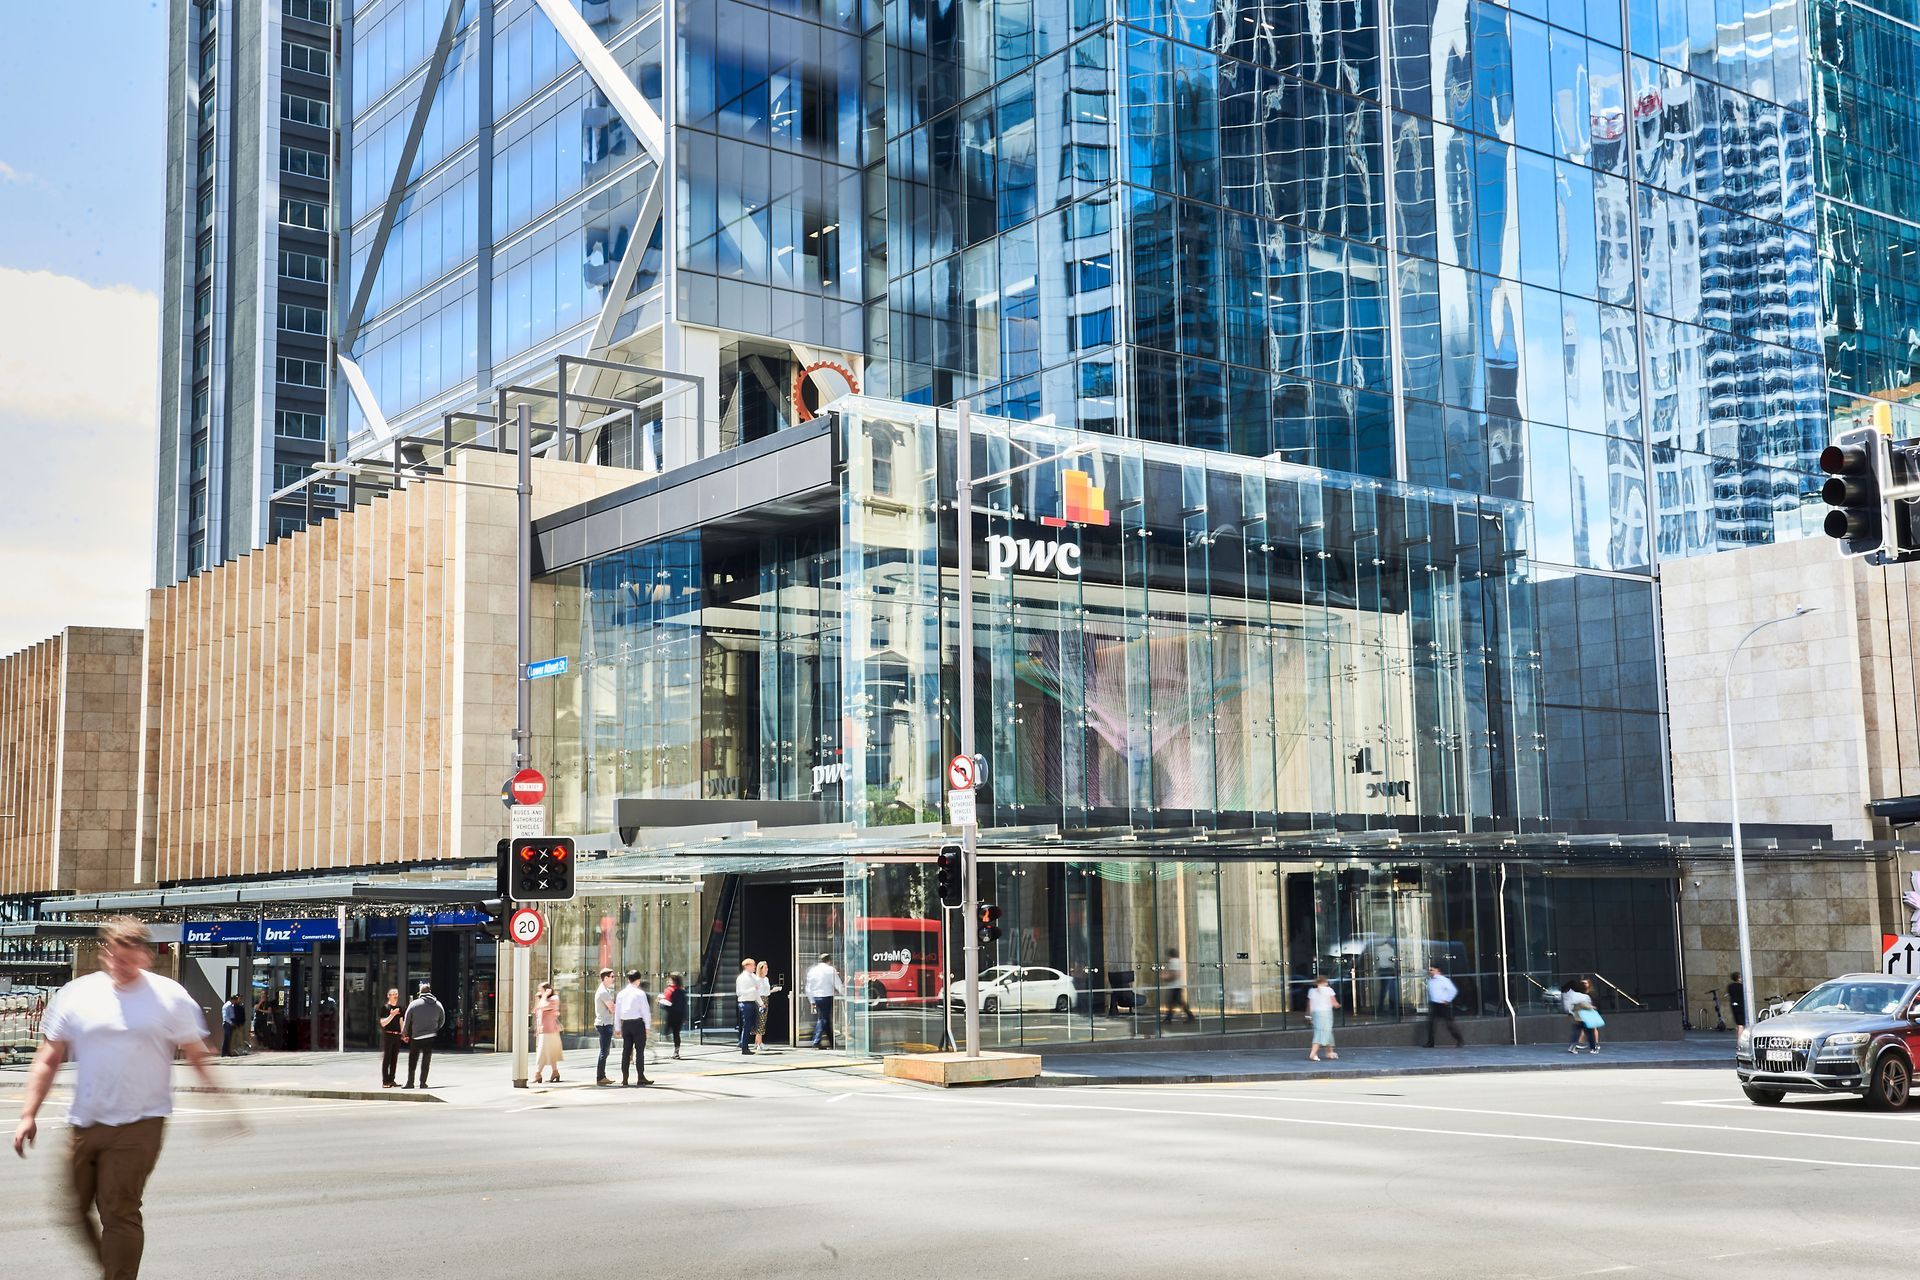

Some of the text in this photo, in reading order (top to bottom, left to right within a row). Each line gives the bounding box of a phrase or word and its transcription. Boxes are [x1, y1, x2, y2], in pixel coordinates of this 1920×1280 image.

[985, 535, 1081, 580] pwc
[544, 661, 559, 674] Albert
[812, 763, 852, 793] pwc
[265, 927, 291, 941] bnz
[519, 920, 535, 934] 20
[187, 930, 211, 942] bnz
